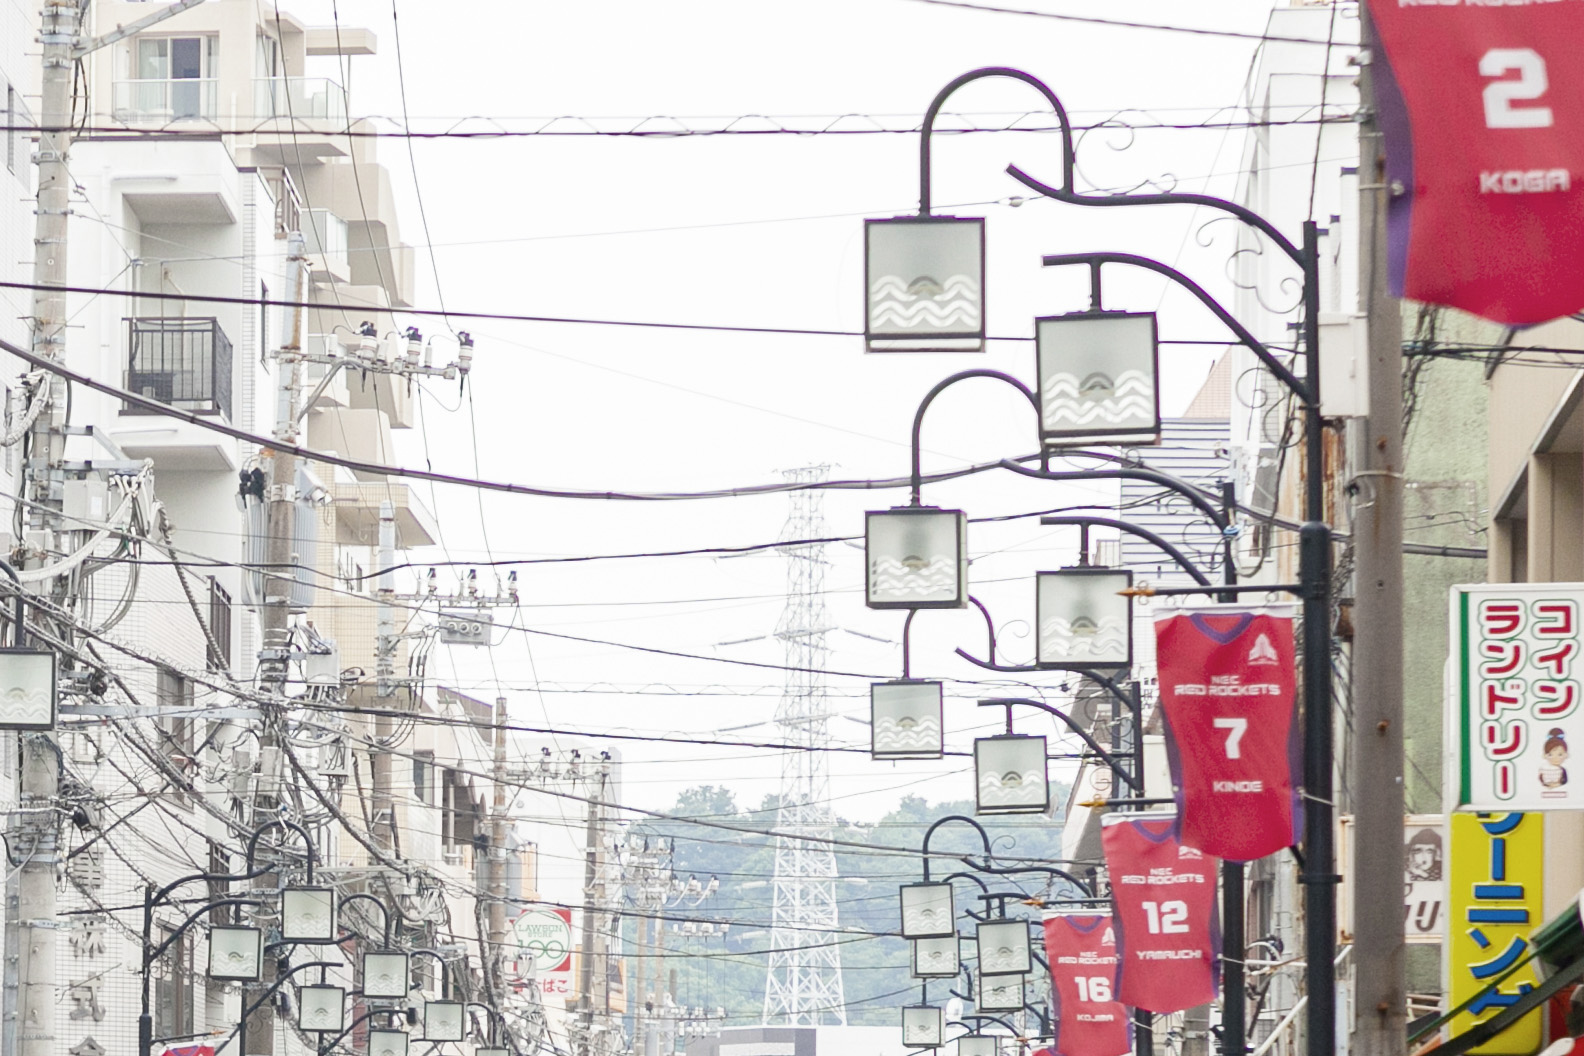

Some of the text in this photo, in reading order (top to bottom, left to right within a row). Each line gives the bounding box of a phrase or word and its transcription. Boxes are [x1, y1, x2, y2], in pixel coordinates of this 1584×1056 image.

[1478, 48, 1554, 129] 2
[1480, 168, 1571, 194] KOGA
[1535, 601, 1577, 719] コイン
[1174, 684, 1281, 696] RED ROCKETS
[1211, 675, 1241, 685] NEC
[1481, 601, 1525, 797] ランドリー
[1213, 717, 1248, 760] 7
[1121, 874, 1205, 884] RED ROCKETS
[1151, 868, 1173, 876] NEC
[1142, 900, 1189, 934] 12
[518, 924, 562, 932] LAWSON
[1136, 949, 1202, 960] YAMAUCHI
[537, 978, 568, 993] ばこ
[1074, 976, 1111, 1002] 16
